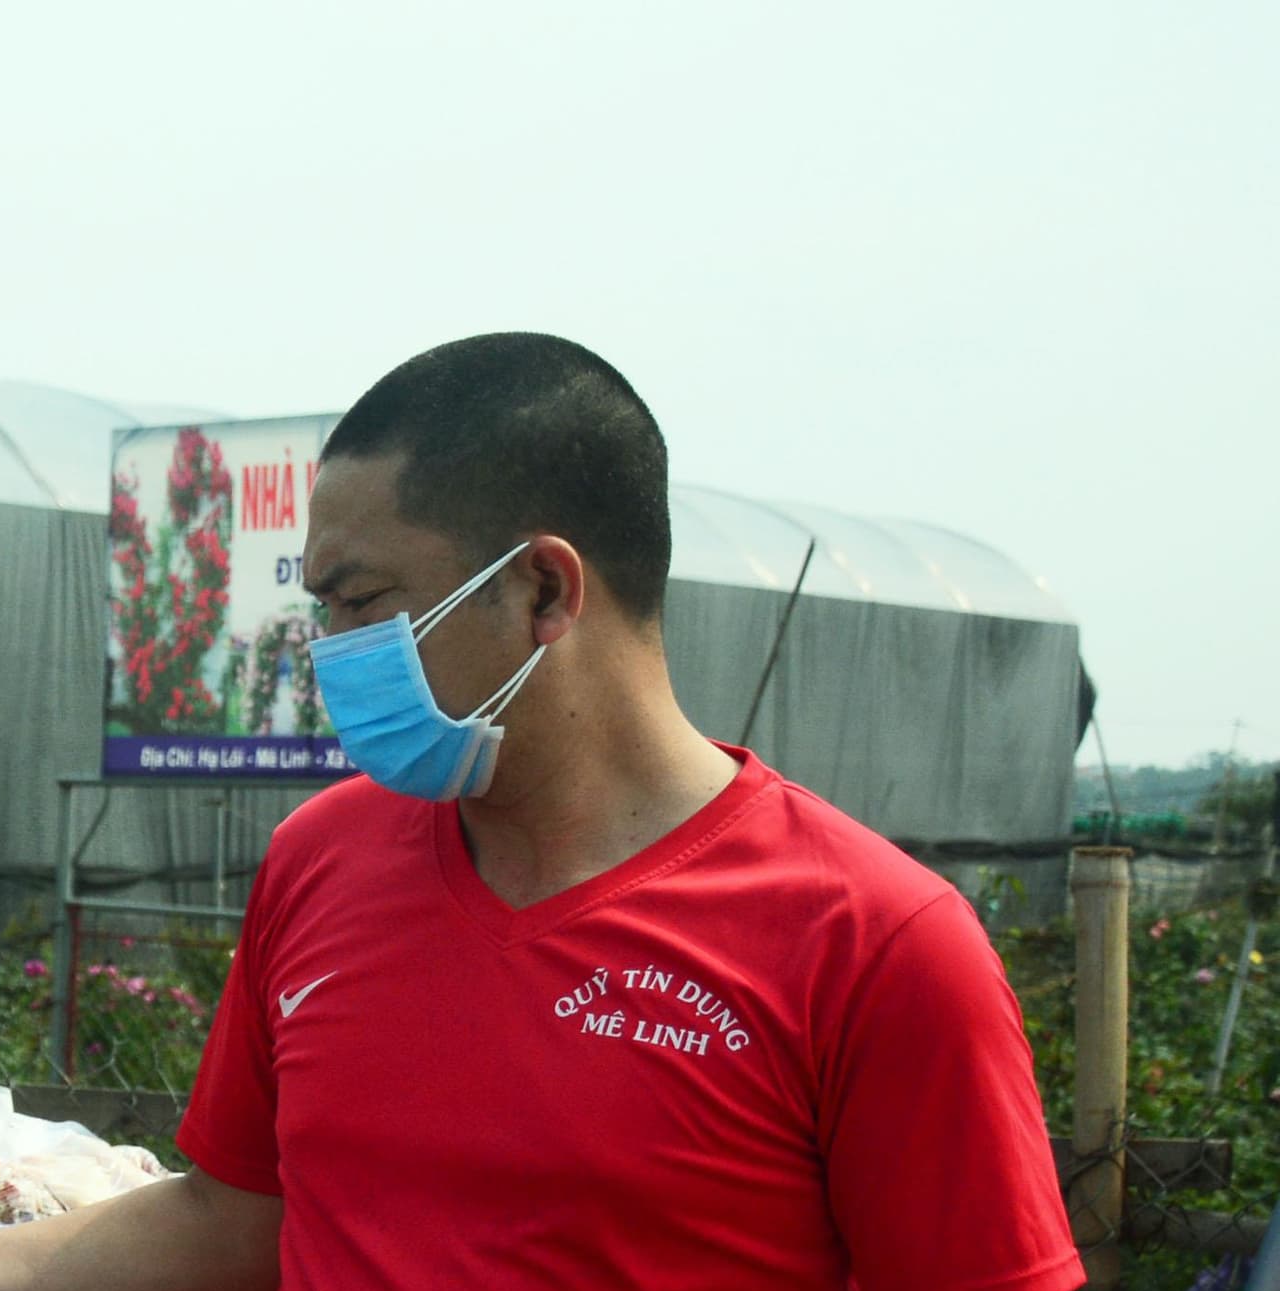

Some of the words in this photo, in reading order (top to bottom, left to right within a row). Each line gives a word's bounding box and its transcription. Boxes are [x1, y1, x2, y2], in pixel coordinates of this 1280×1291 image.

[553, 966, 609, 1018] QUỸ
[622, 964, 674, 993] TÍN
[677, 980, 750, 1052] DỤNG
[580, 1010, 626, 1038] MÊ
[633, 1020, 710, 1056] LINH
